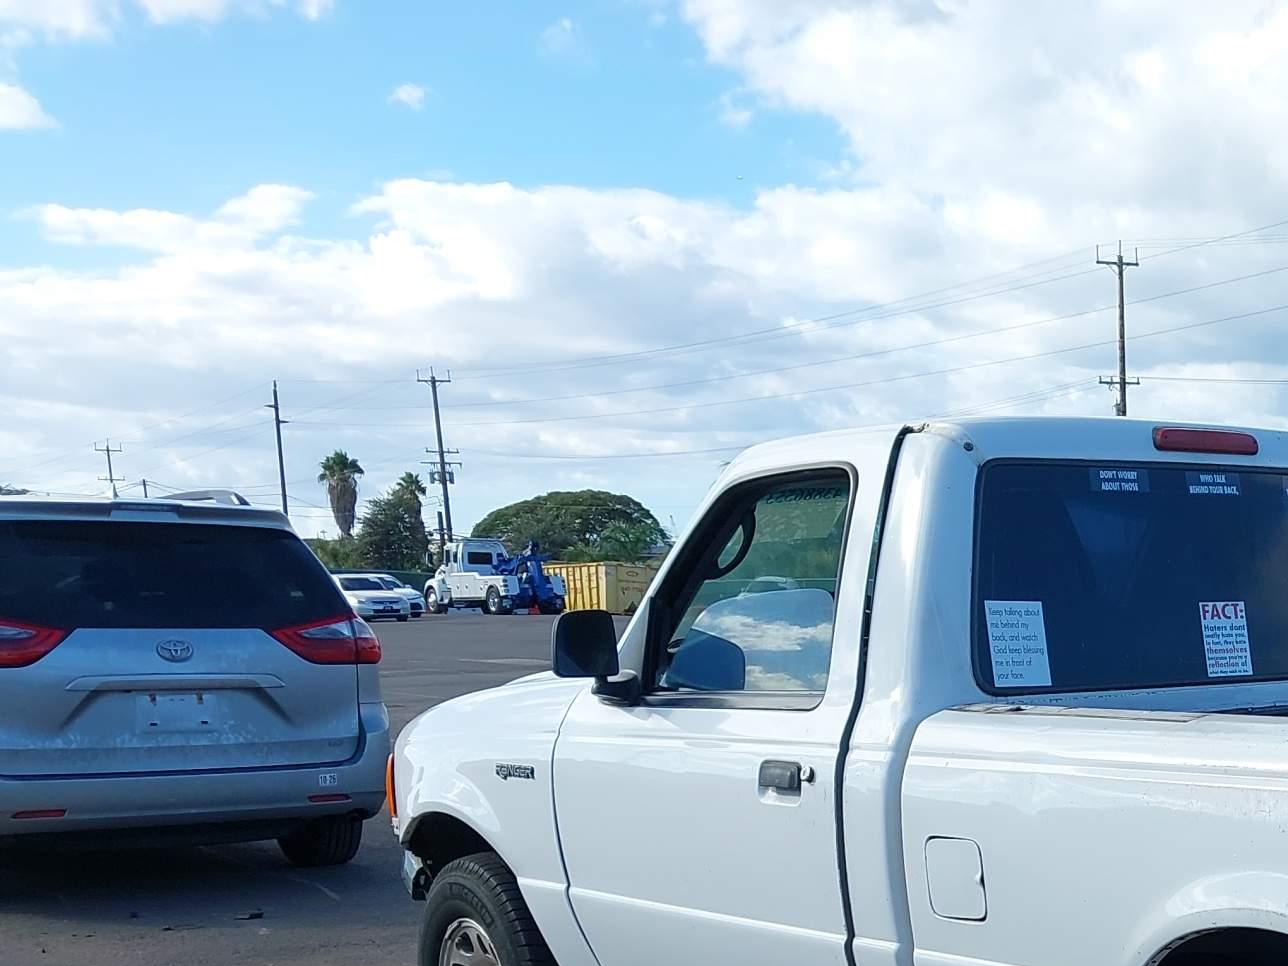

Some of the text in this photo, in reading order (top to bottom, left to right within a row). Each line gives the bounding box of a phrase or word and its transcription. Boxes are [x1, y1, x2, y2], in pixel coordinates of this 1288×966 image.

[1118, 471, 1137, 480] WORRY
[1200, 474, 1225, 483] WHO TALK
[1102, 481, 1139, 491] ABOUT THOSE
[1190, 485, 1209, 494] BEHIND
[1209, 485, 1223, 494] YOUR
[1004, 608, 1022, 618] talking
[1024, 607, 1040, 616] about
[1201, 603, 1244, 620] FACT:
[1000, 619, 1020, 629] behind
[1020, 622, 1029, 630] my
[1204, 624, 1227, 632] Haters
[1009, 632, 1020, 641] and
[1021, 632, 1039, 641] watch
[994, 645, 1044, 655] God keep blessing
[1207, 647, 1247, 655] themselves
[1011, 657, 1025, 666] front
[1026, 656, 1032, 666] of
[1209, 661, 1239, 669] reflection
[997, 673, 1010, 681] your
